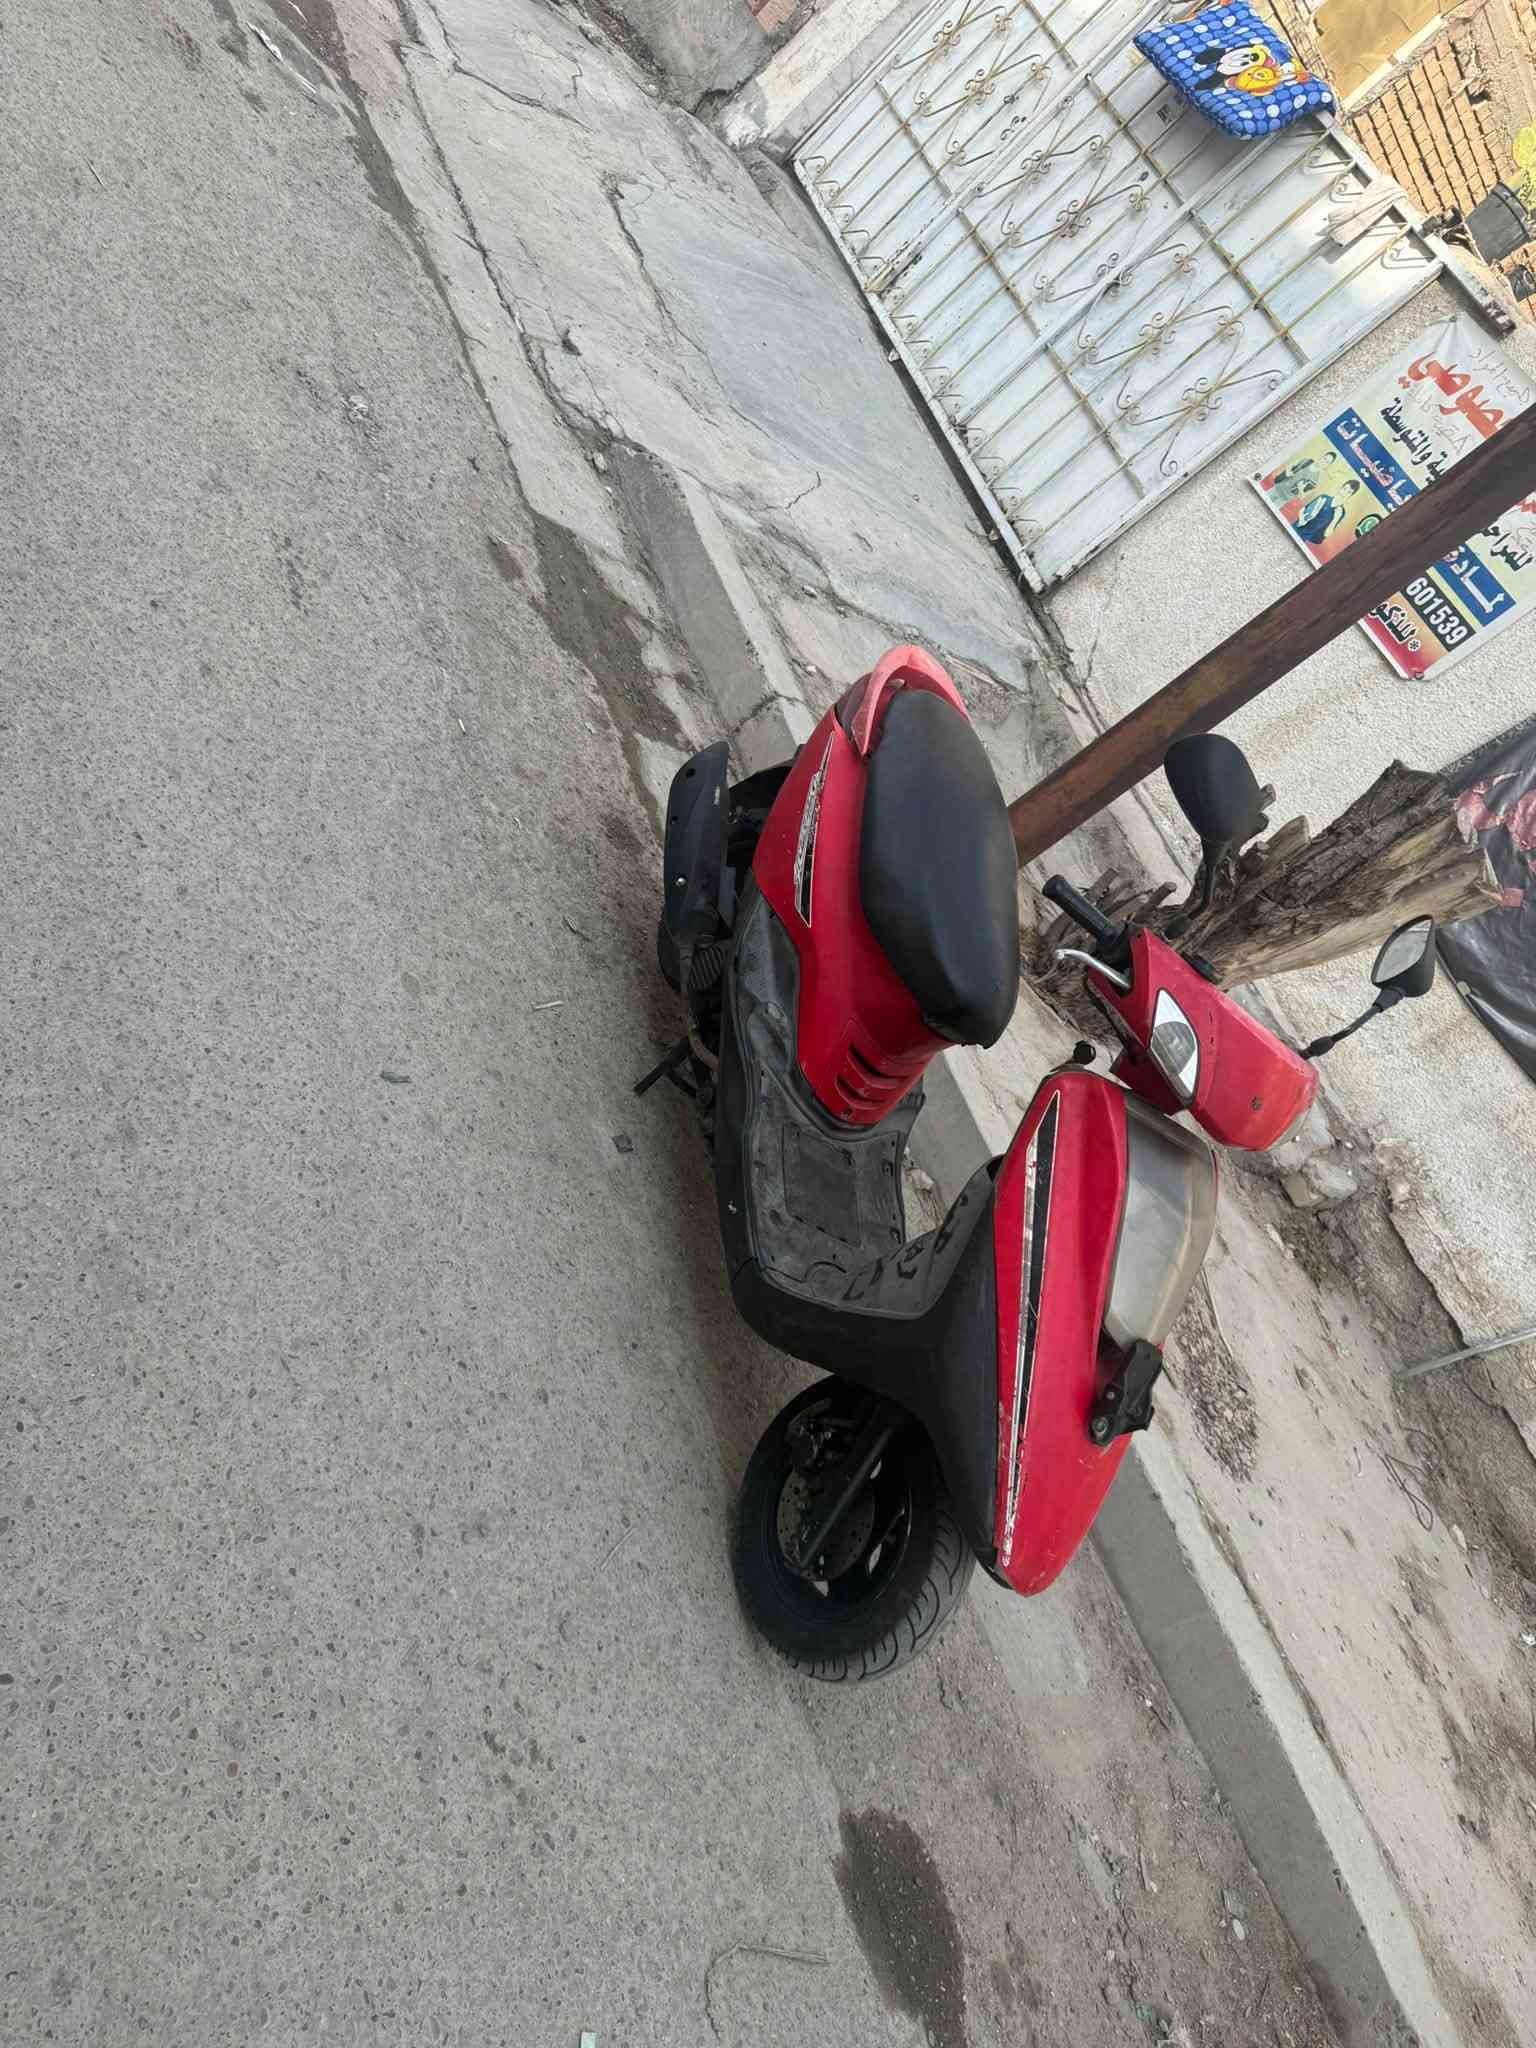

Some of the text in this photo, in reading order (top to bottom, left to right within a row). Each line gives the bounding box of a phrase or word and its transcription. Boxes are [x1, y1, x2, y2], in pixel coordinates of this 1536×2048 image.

[1398, 351, 1504, 440] صوصي
[1380, 397, 1433, 466] والمتوسطة
[1337, 417, 1505, 613] لمادة ياضيات
[1478, 525, 1533, 572] للمراح
[1368, 602, 1416, 644] للذكو
[1405, 576, 1468, 645] 601539
